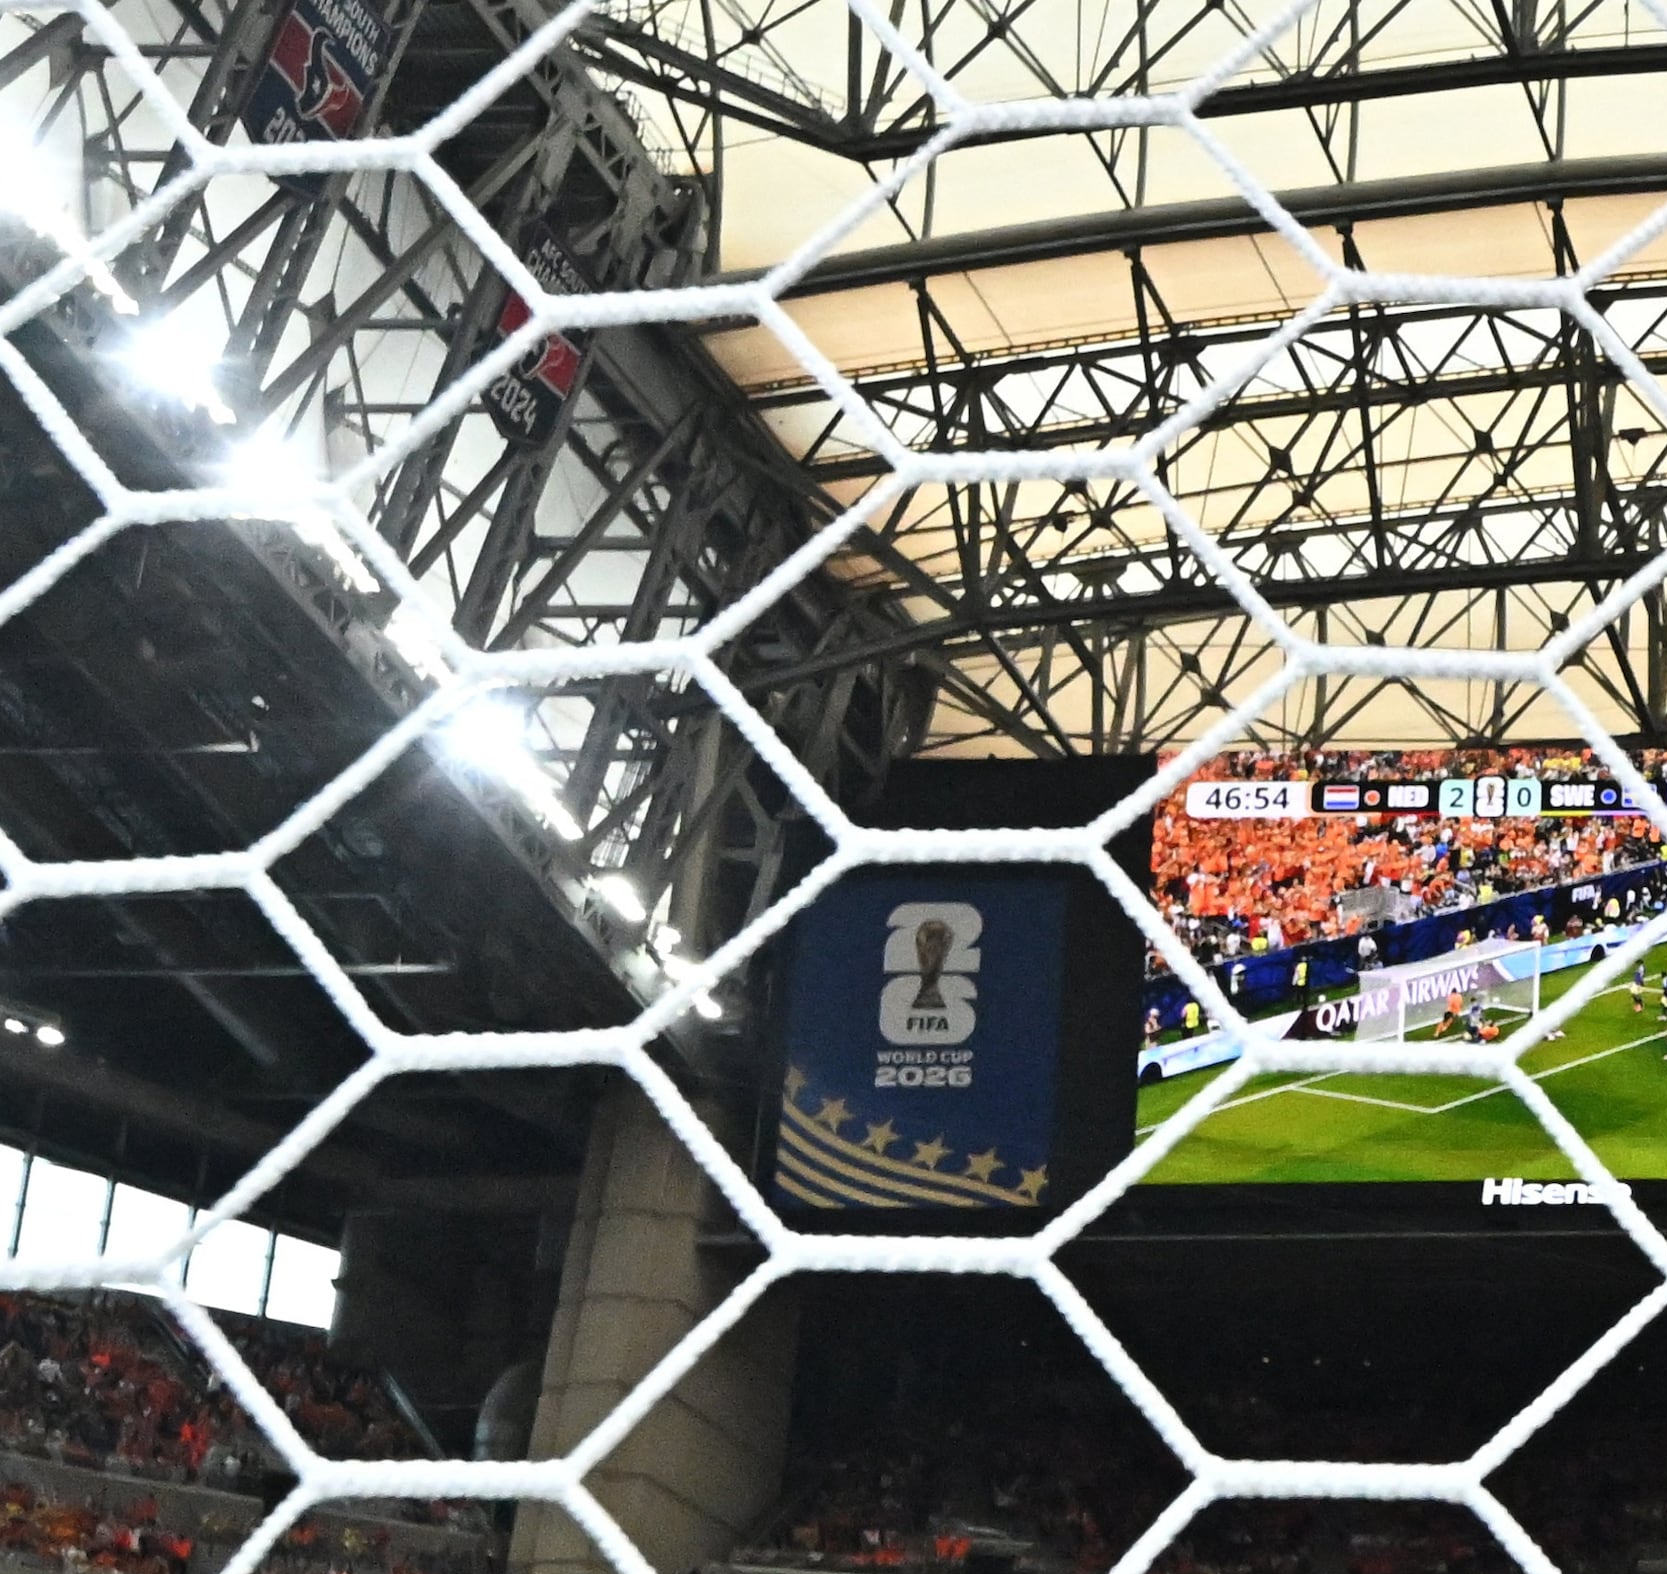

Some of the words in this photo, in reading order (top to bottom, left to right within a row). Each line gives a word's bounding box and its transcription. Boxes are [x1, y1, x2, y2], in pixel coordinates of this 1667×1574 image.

[313, 0, 378, 75] HAMPIONS
[263, 107, 307, 143] 20
[490, 372, 536, 435] 2024
[1205, 787, 1290, 810] 46:54
[1450, 787, 1464, 808] 2
[1517, 787, 1532, 808] 0
[1550, 784, 1596, 807] SWE
[906, 1015, 950, 1033] FIFA
[1316, 988, 1390, 1032] QATAR
[876, 1050, 934, 1064] WORLD
[939, 1050, 973, 1064] CUP
[874, 1066, 973, 1087] 2026
